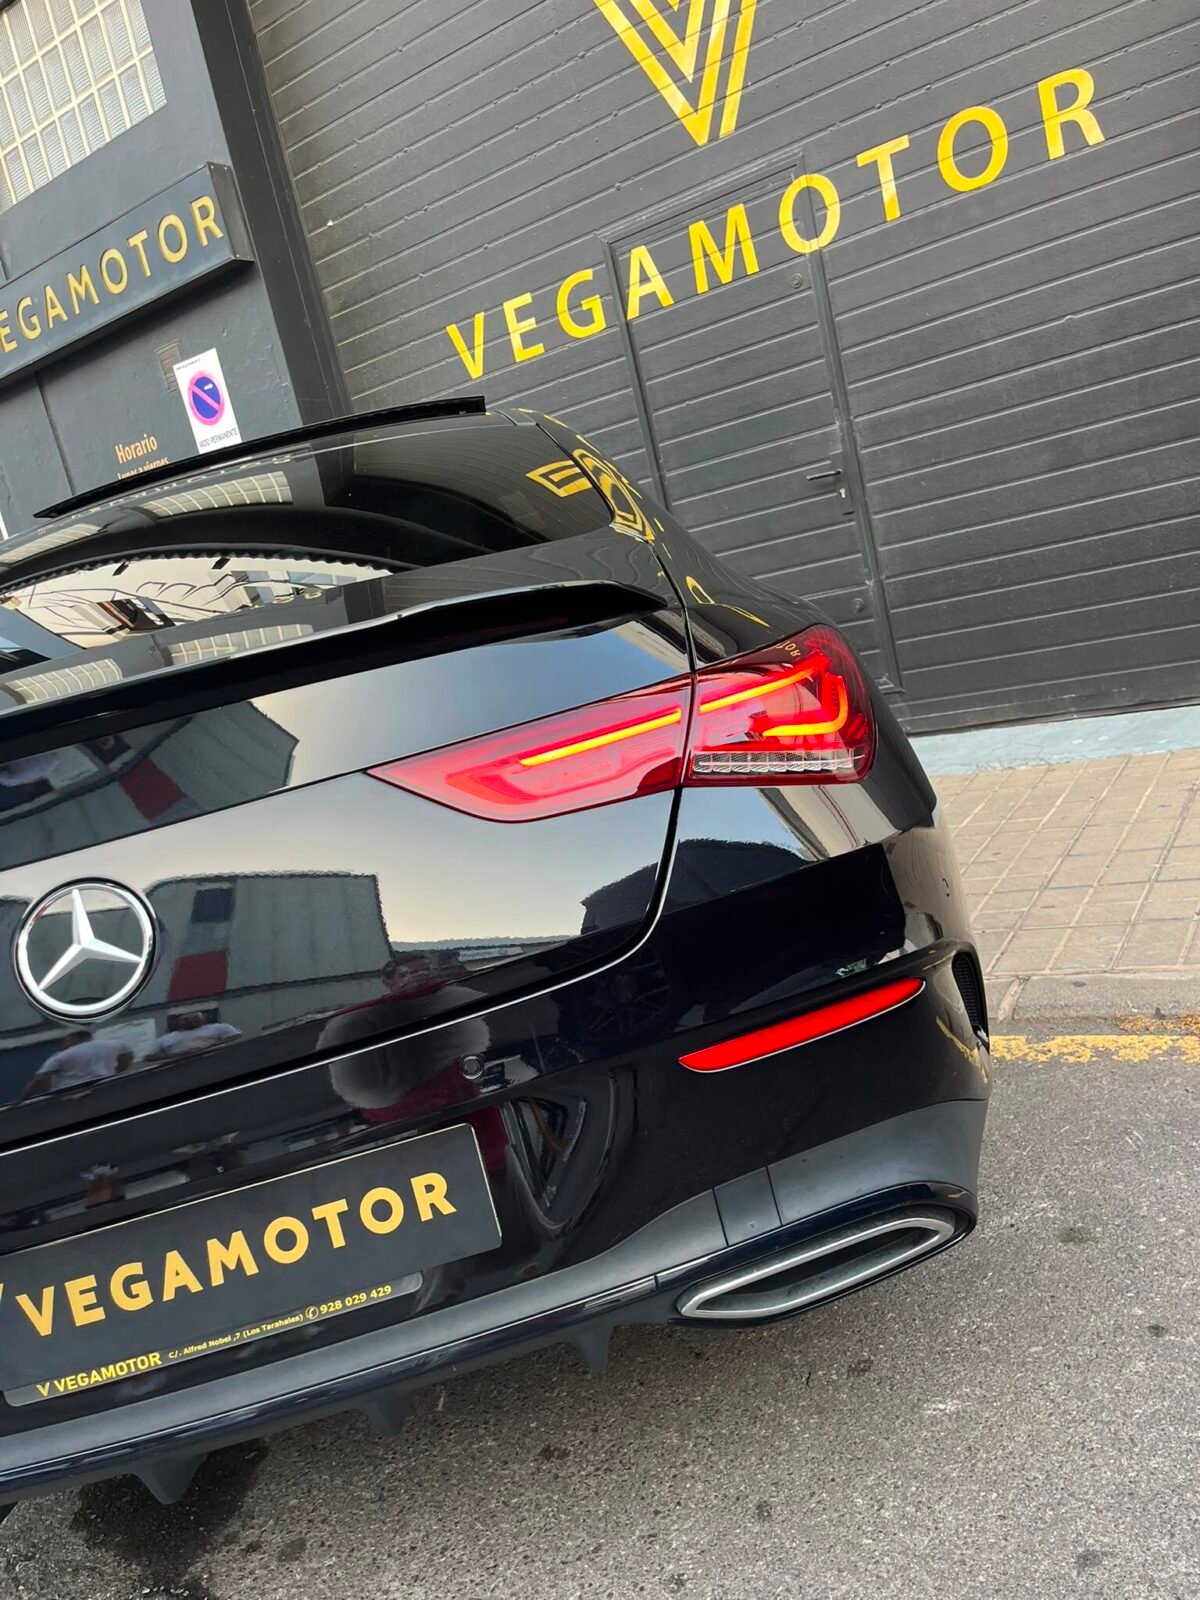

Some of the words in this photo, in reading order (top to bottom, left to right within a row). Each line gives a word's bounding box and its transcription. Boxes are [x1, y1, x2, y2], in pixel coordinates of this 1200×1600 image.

[446, 68, 1105, 379] VEGAMOTOR
[115, 433, 158, 464] Horario
[15, 1172, 457, 1336] VEGAMOTOR
[54, 1351, 162, 1393] VEGAMOTOR
[183, 1343, 207, 1355] Alfred
[208, 1335, 231, 1348] Nobel
[243, 1328, 260, 1338] (Los
[261, 1313, 303, 1331] Tarahales)
[320, 1300, 343, 1314] 928
[345, 1292, 367, 1306] 029
[370, 1285, 392, 1299] 429
